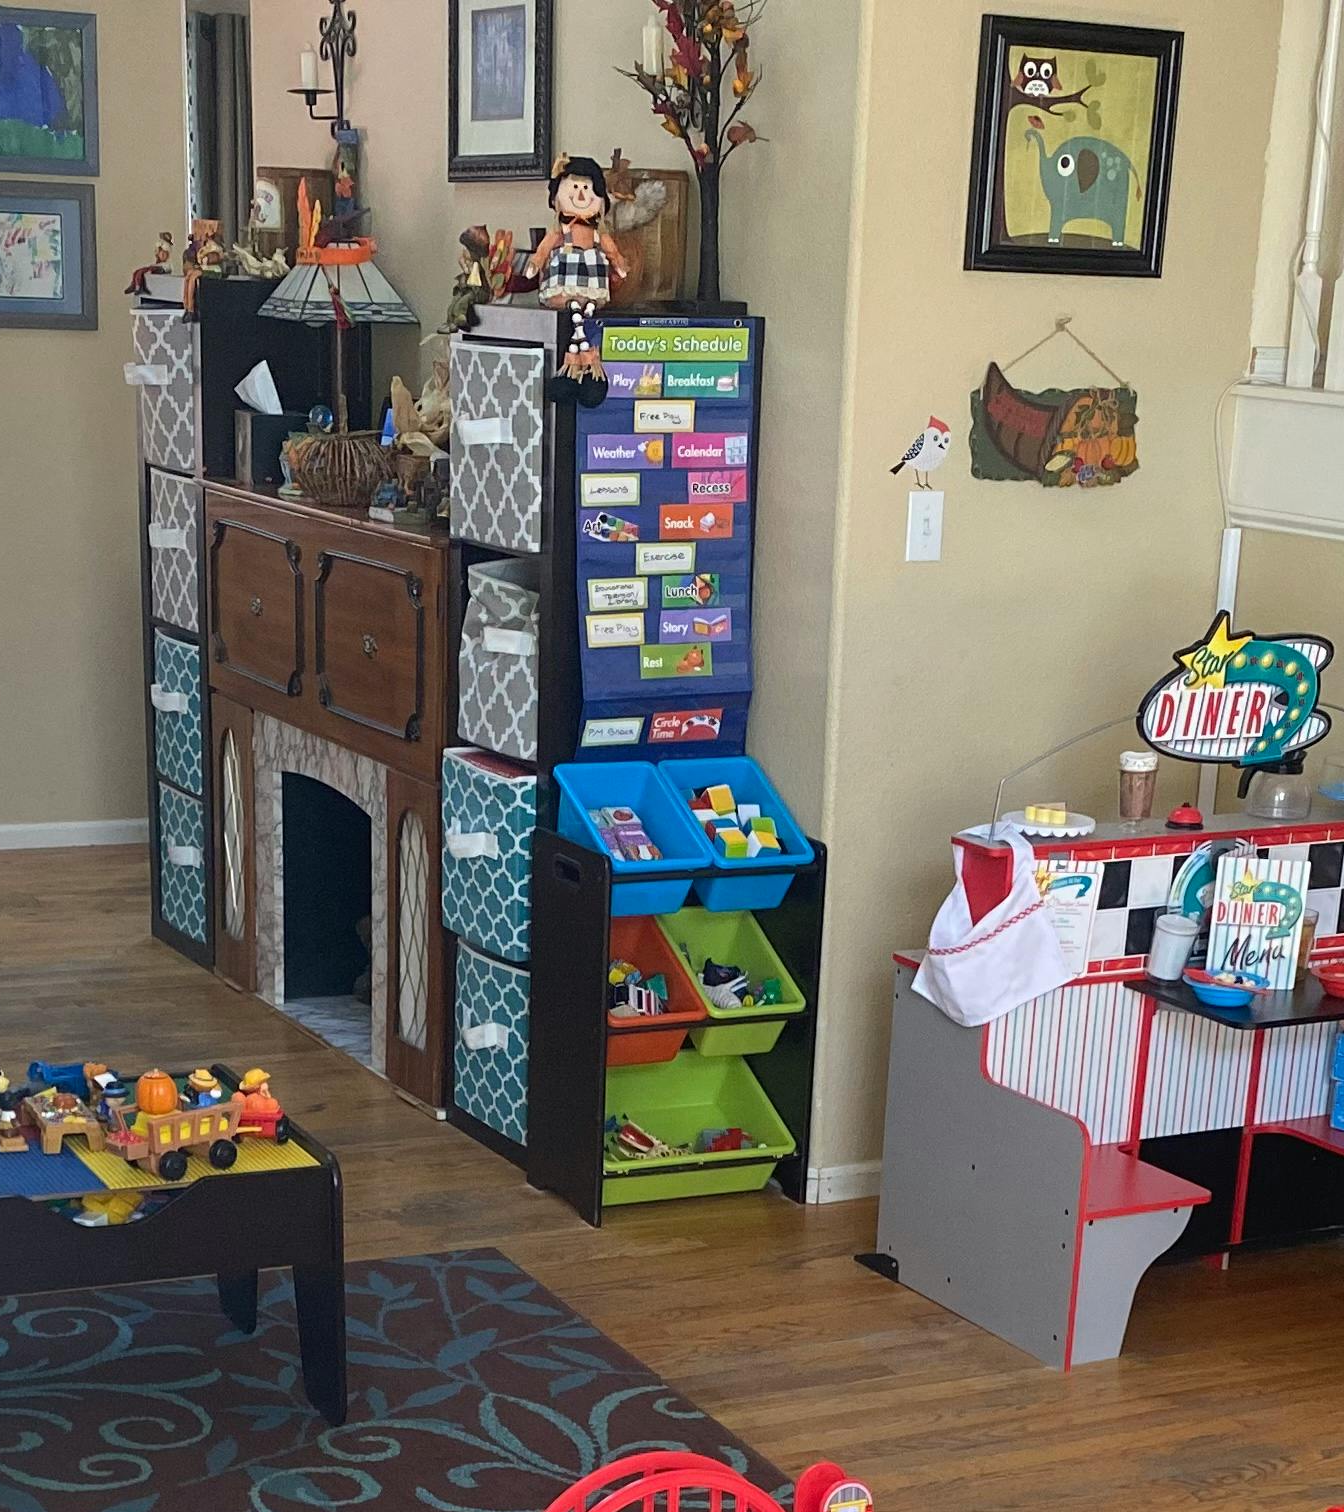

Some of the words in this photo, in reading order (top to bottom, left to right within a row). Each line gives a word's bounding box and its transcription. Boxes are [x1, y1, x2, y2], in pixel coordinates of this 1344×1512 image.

[609, 336, 667, 355] Today's
[673, 335, 742, 352] Schedule
[613, 373, 636, 389] Play
[667, 374, 715, 387] Breakfast
[639, 412, 660, 421] Free
[592, 446, 636, 459] Weather
[677, 444, 723, 458] Calendar
[692, 483, 731, 494] Recess
[584, 520, 601, 532] Art
[664, 516, 694, 529] Snack
[665, 585, 698, 597] Lunch
[594, 624, 614, 634] Free
[616, 624, 640, 637] Play
[662, 621, 689, 636] Story
[643, 656, 663, 669] Rest
[1184, 646, 1235, 687] Star
[1155, 690, 1267, 738] DINER
[654, 715, 681, 728] Circle
[652, 728, 675, 739] Time
[1230, 881, 1255, 899] Star
[1216, 902, 1278, 925] DINER
[1221, 934, 1285, 970] Menu
